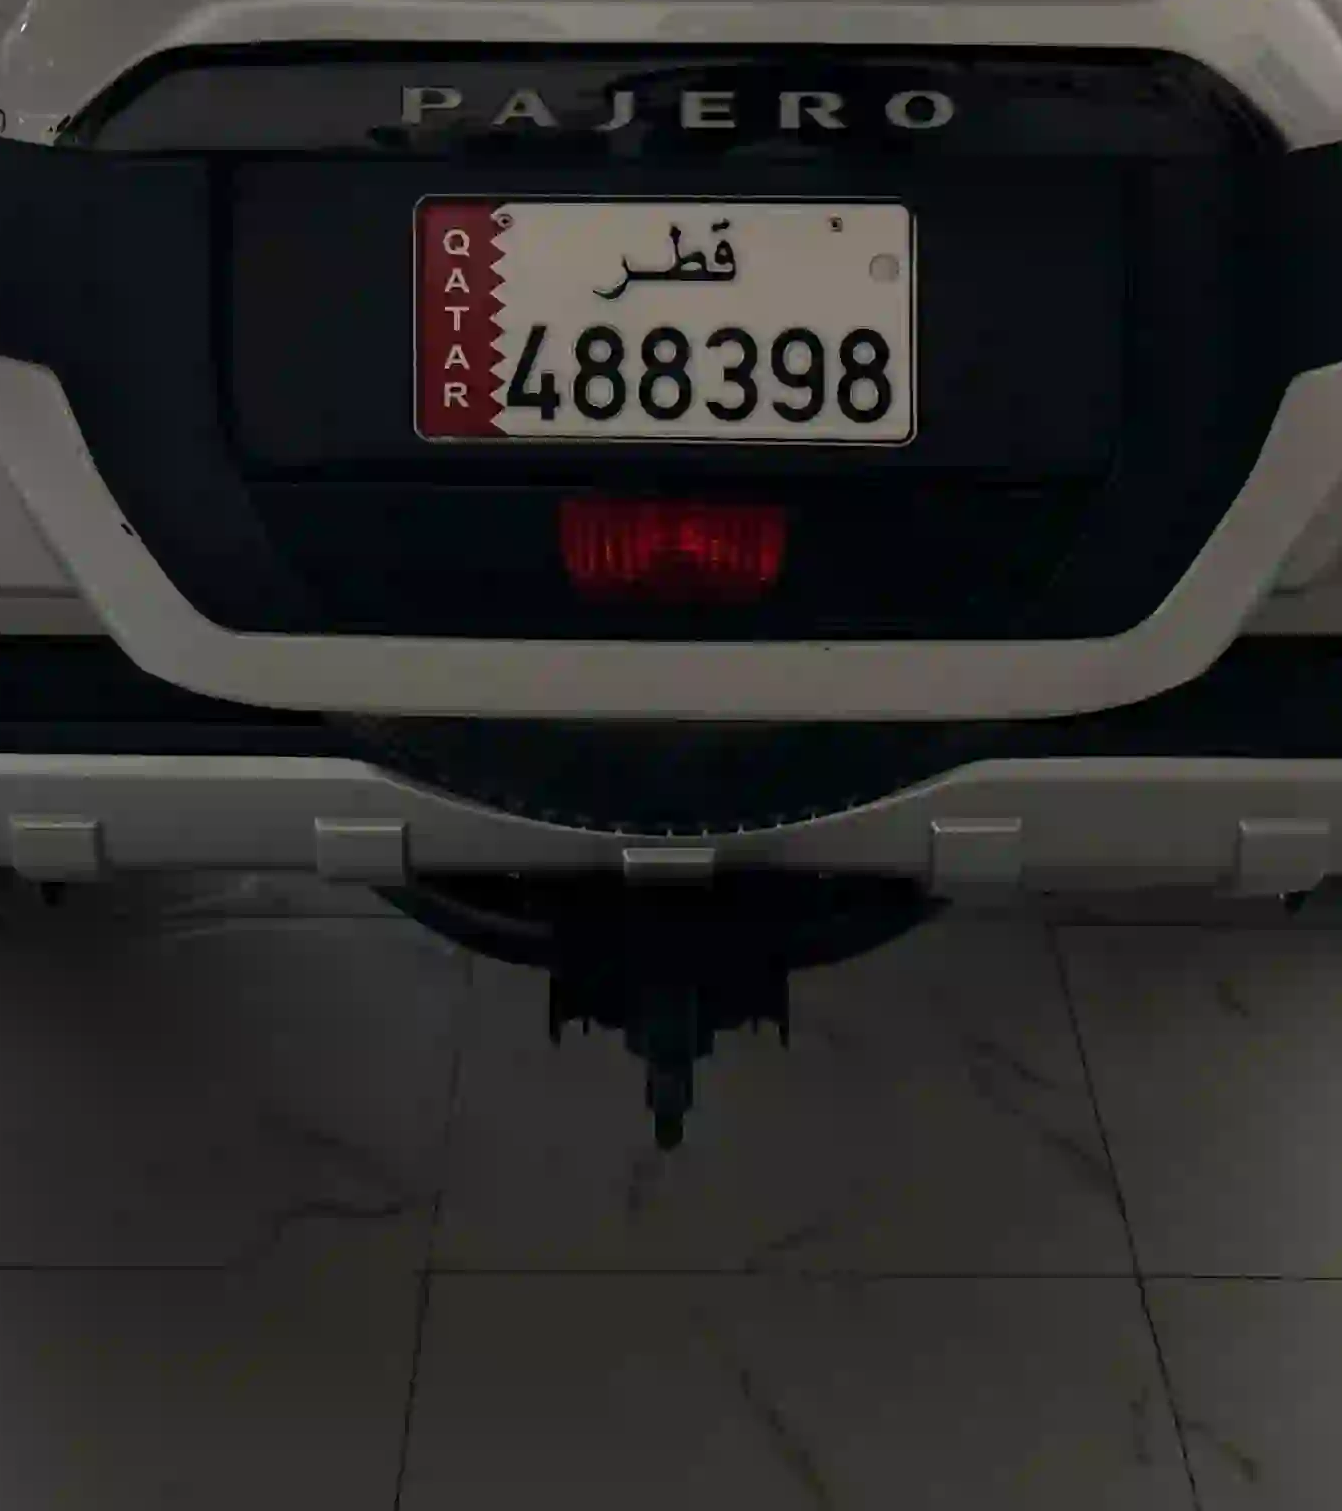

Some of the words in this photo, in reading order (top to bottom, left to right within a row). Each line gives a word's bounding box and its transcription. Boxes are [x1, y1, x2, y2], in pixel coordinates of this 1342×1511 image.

[401, 86, 956, 131] PAJERO
[591, 217, 738, 301] قطر
[442, 228, 471, 409] QATAR
[504, 323, 895, 425] 488398
